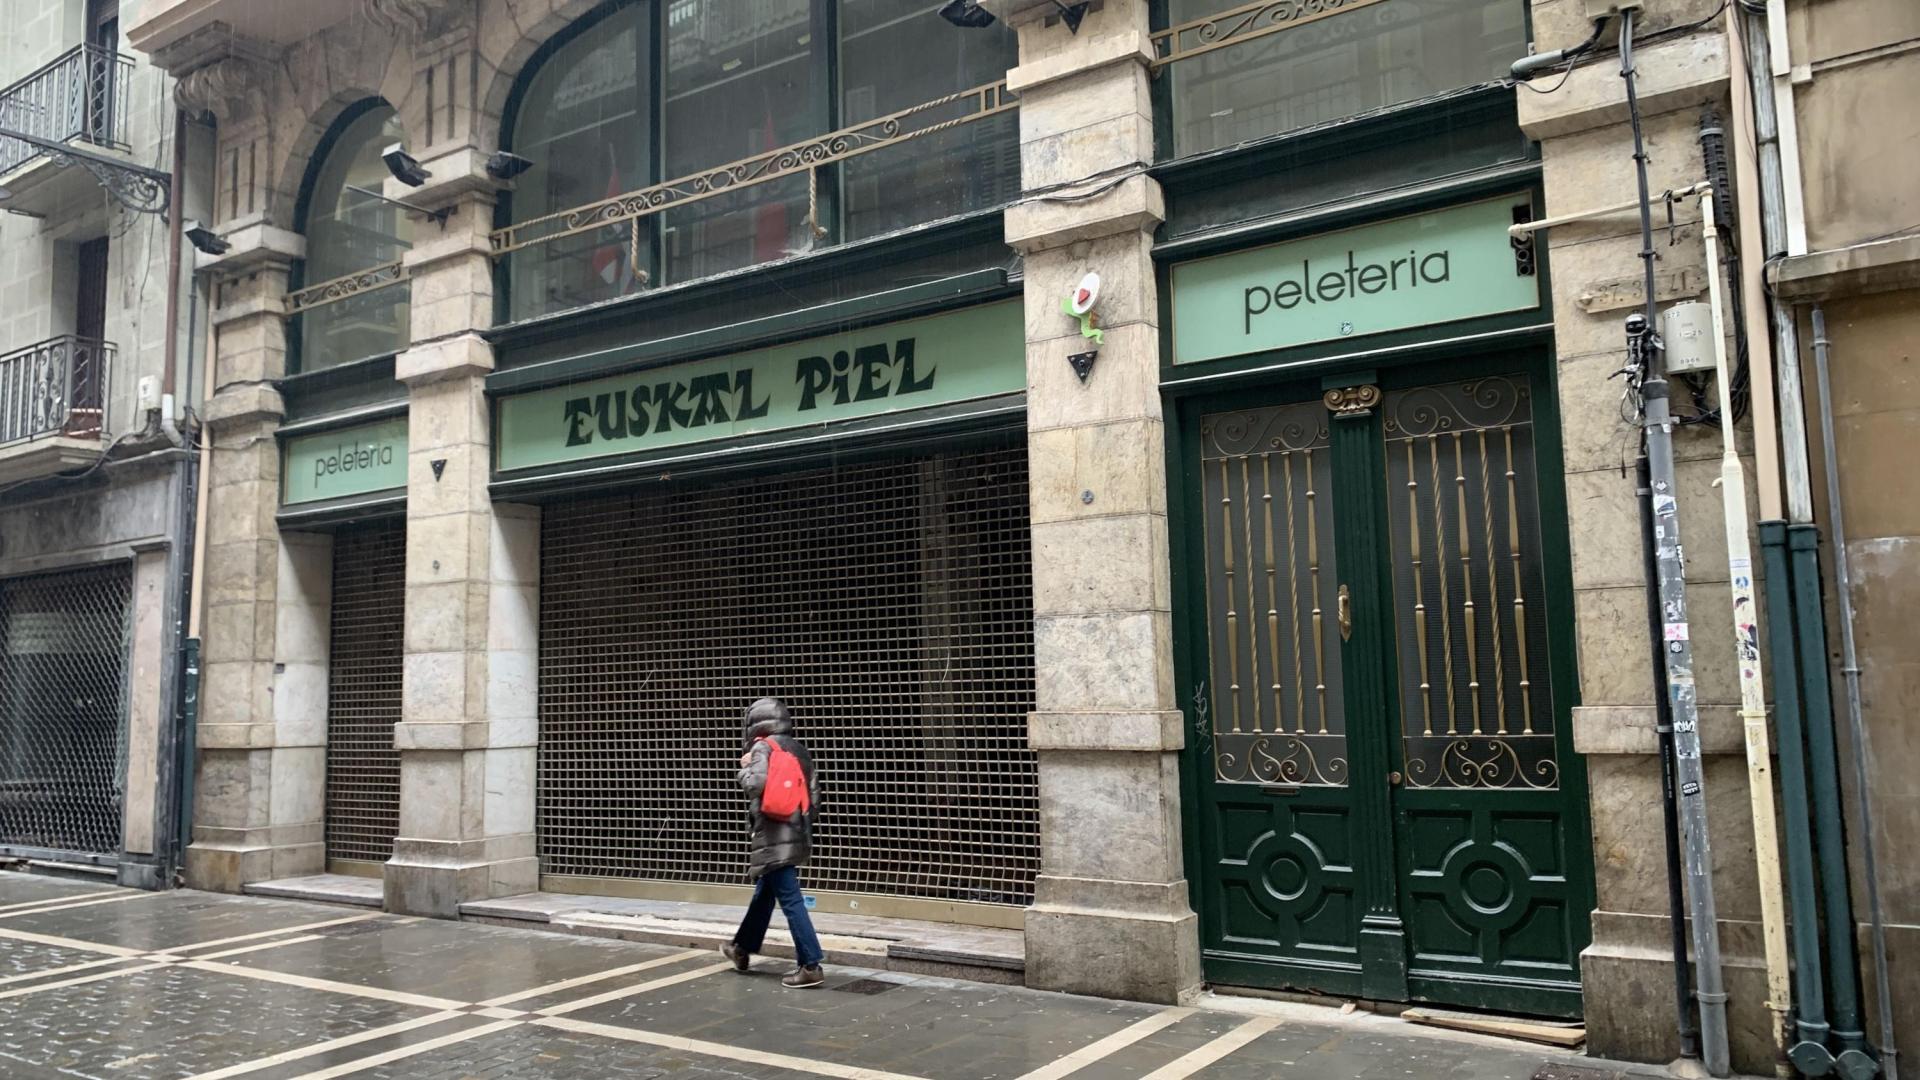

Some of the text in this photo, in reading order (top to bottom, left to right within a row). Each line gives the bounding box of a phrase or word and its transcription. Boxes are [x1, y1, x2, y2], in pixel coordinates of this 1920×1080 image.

[1244, 249, 1450, 335] peleteria
[564, 367, 771, 448] EUSKAL
[314, 440, 393, 489] peleteria
